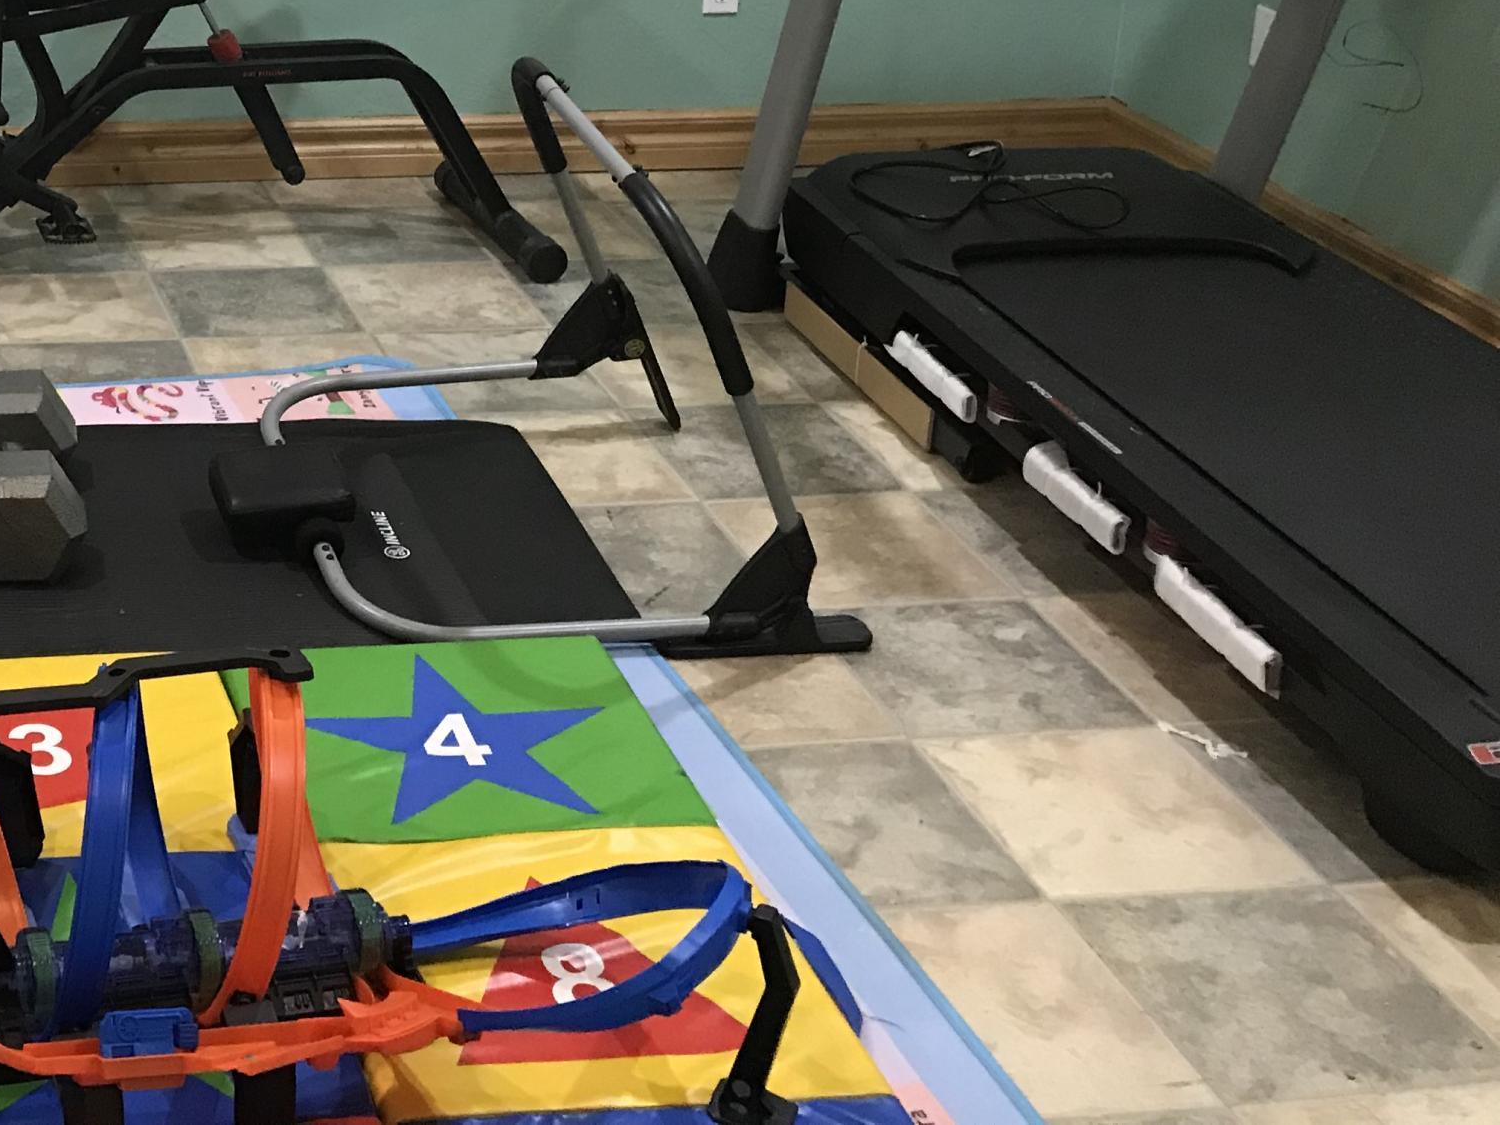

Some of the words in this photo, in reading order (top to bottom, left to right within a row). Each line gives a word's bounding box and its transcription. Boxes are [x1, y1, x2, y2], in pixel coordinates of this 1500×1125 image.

[370, 511, 401, 545] INCLINE
[8, 723, 72, 776] 3
[423, 713, 493, 766] 4
[541, 942, 616, 1004] 8
